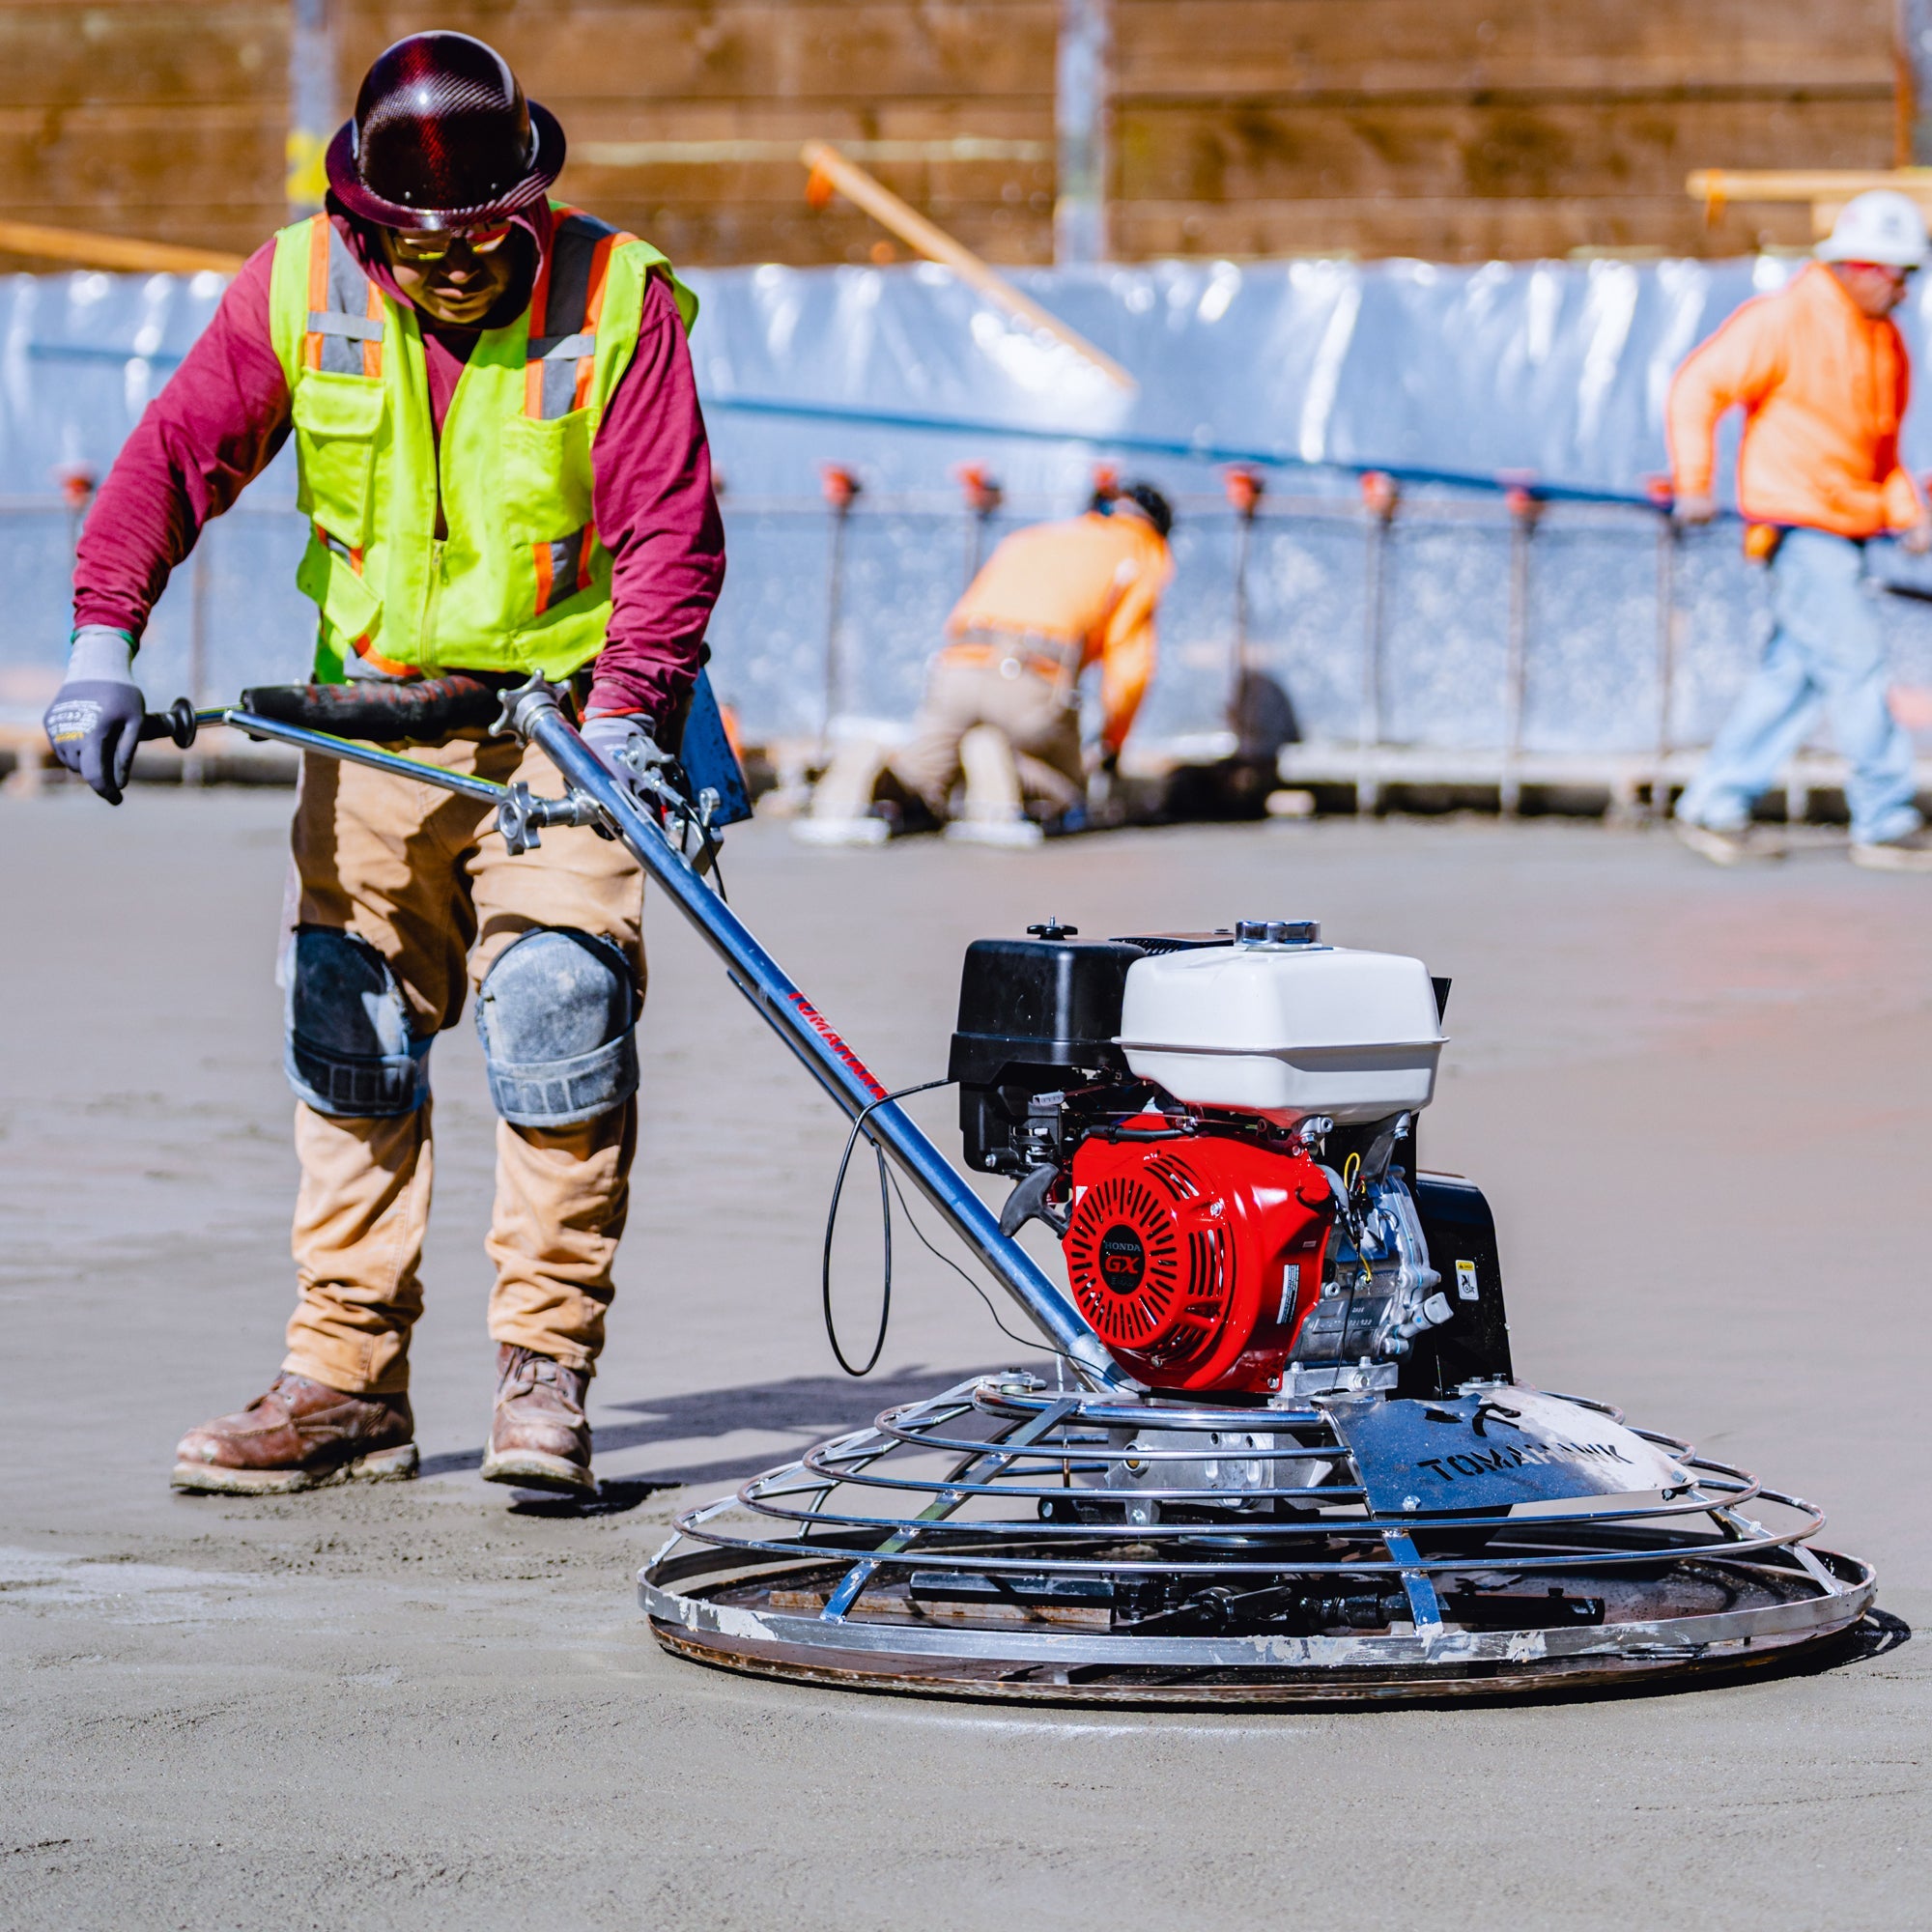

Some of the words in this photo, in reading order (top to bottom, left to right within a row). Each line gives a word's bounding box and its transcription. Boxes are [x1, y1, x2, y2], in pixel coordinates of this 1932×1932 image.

[1104, 1241, 1142, 1252] HONDA
[1105, 1255, 1140, 1274] GX
[1416, 1443, 1634, 1482] TOMAHAWK
